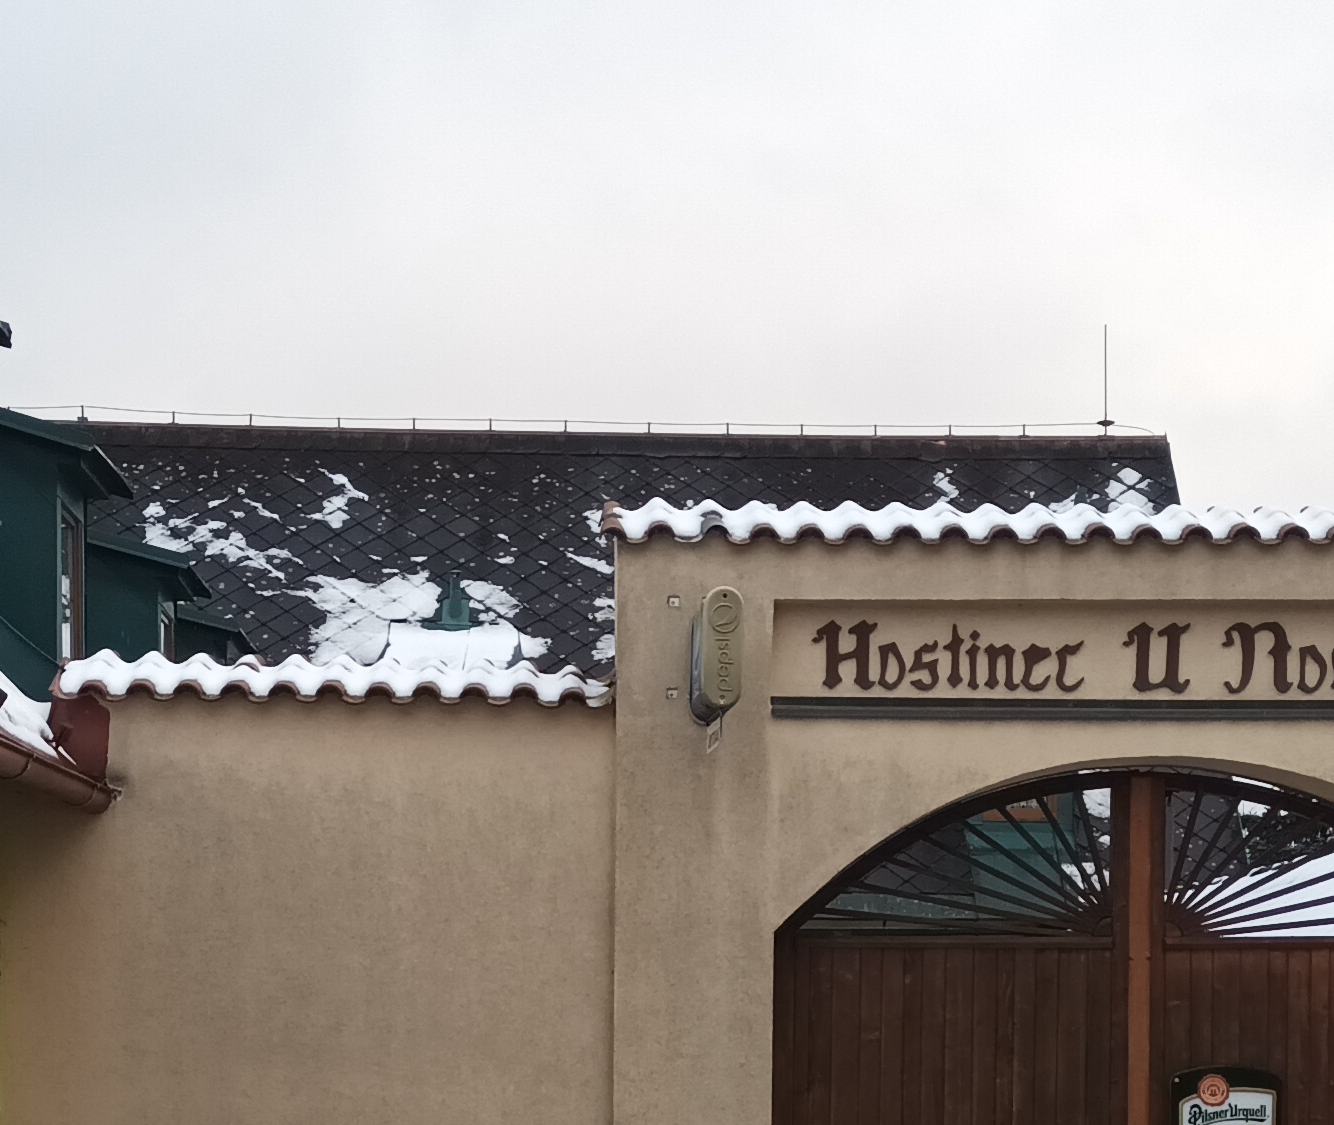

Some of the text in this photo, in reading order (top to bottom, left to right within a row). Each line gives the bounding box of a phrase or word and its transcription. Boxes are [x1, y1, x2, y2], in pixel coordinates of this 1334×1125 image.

[812, 620, 1085, 693] Hostinec
[1123, 622, 1192, 694] U
[1228, 1103, 1267, 1123] Urquell
